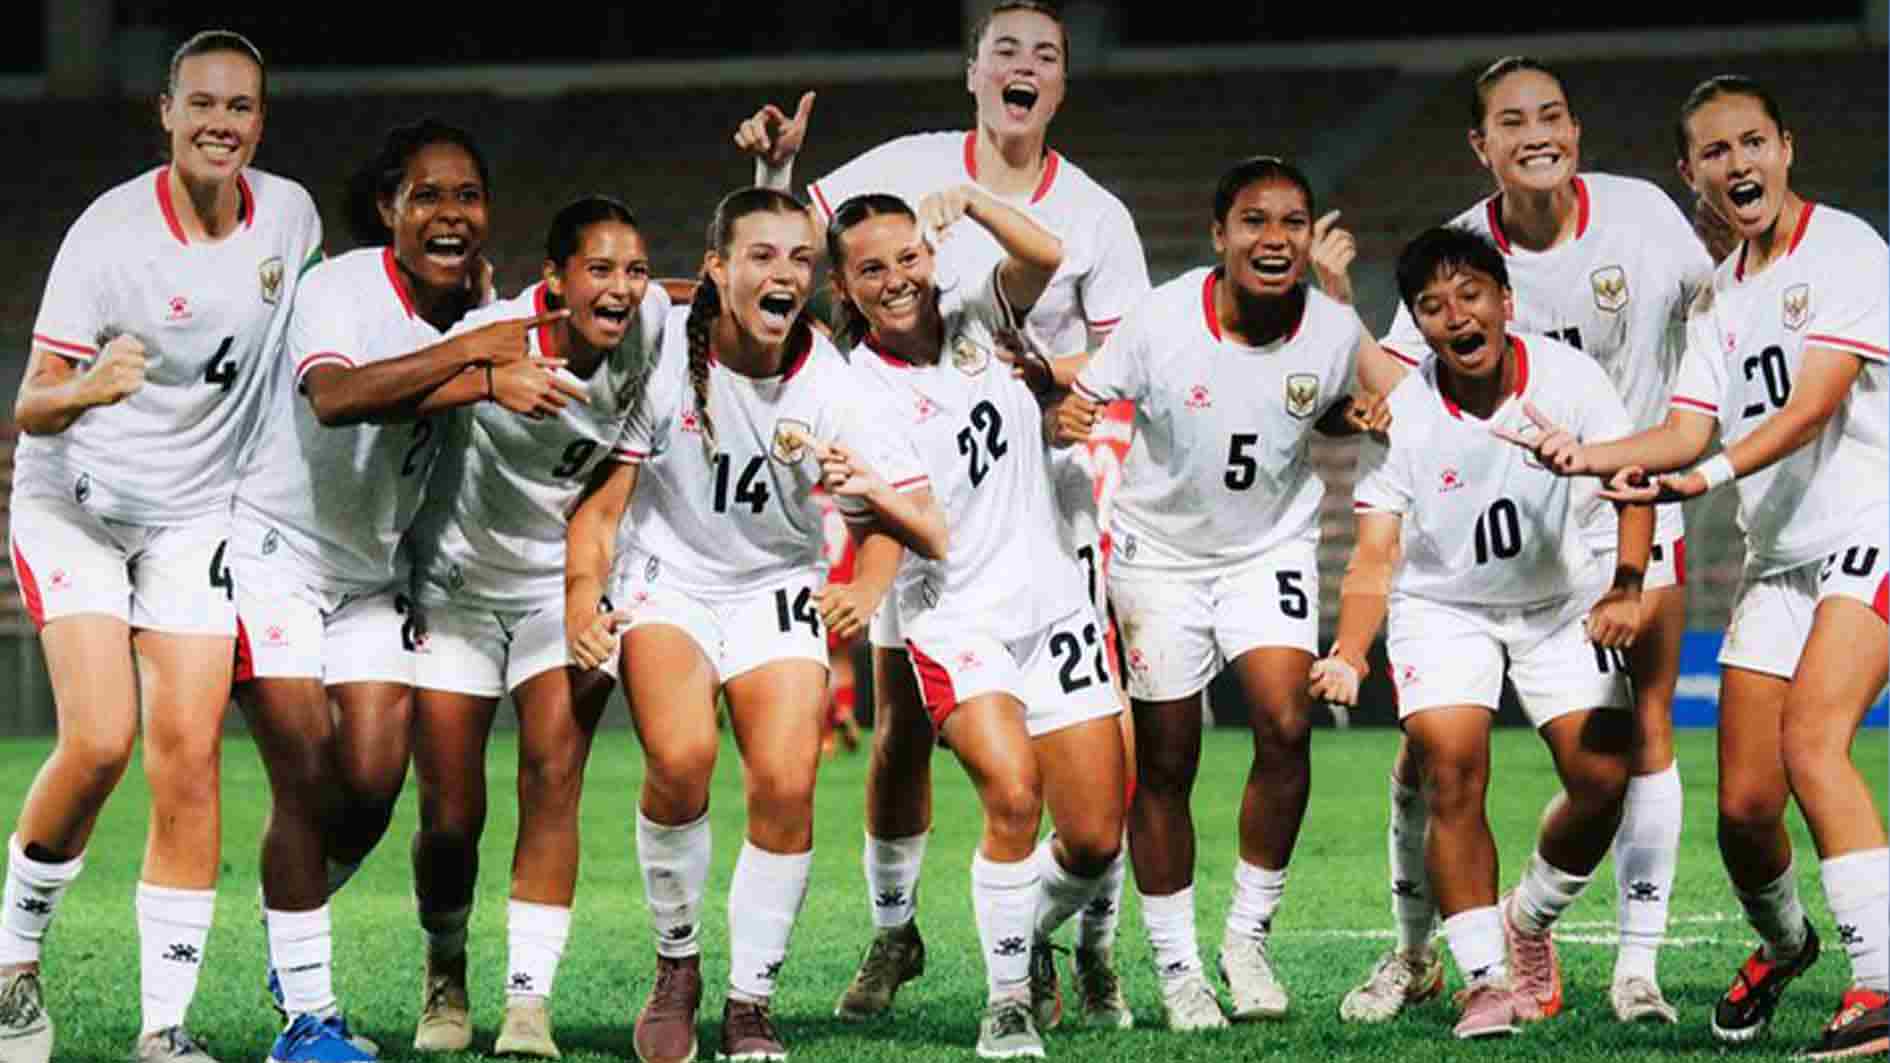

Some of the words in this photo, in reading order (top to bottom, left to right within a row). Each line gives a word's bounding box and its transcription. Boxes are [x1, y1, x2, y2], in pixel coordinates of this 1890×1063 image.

[205, 335, 237, 392] 4
[1742, 346, 1791, 418] 20
[402, 419, 433, 476] 2
[552, 437, 598, 478] 9
[957, 400, 1007, 488] 22
[1225, 434, 1258, 491] 5
[714, 453, 769, 513] 14
[1475, 498, 1522, 564] 10
[209, 539, 233, 600] 4
[1276, 571, 1308, 620] 5
[775, 586, 820, 638] 14
